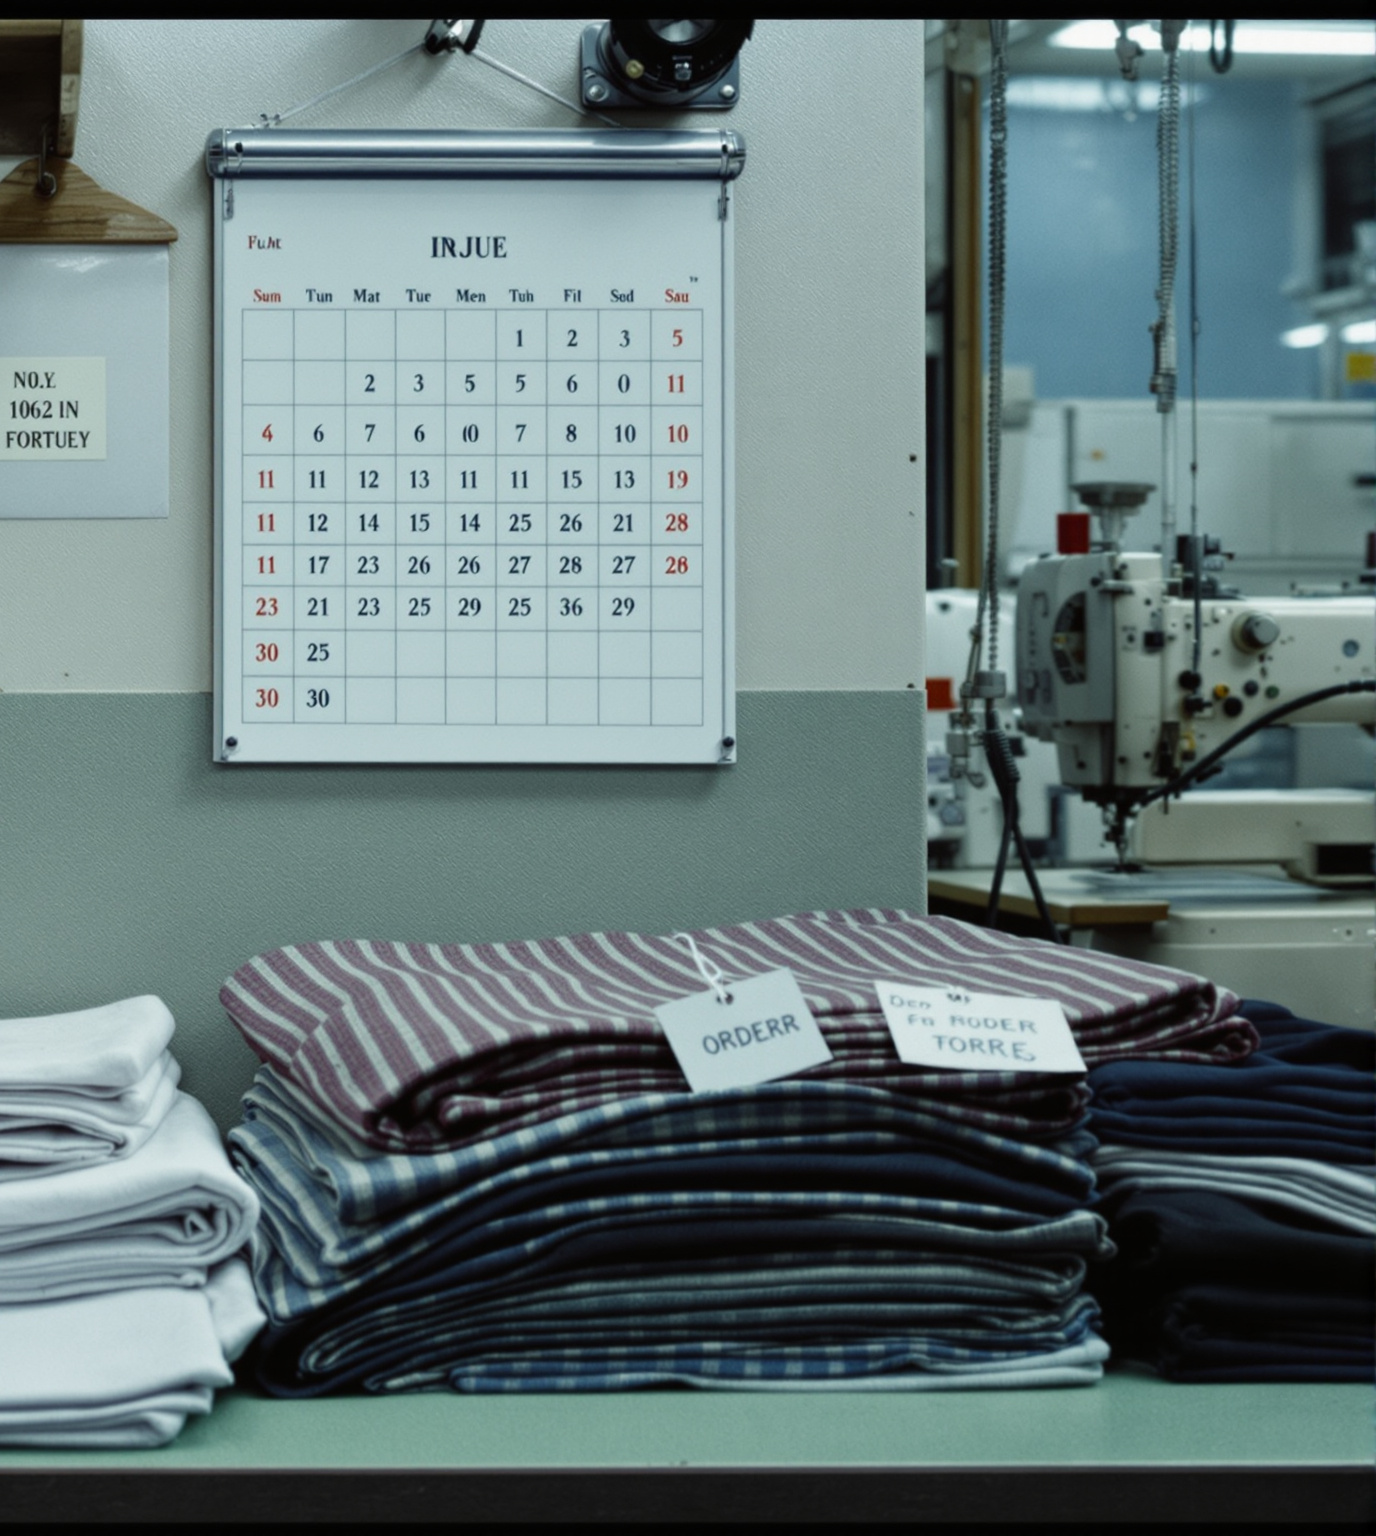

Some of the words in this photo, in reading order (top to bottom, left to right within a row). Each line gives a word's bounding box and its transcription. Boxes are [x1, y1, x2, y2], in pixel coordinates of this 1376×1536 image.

[305, 288, 333, 303] Tun
[353, 288, 380, 303] Mat
[456, 288, 486, 303] Men
[516, 329, 523, 348] 1
[566, 328, 578, 348] 2
[619, 329, 631, 348] 3
[672, 329, 683, 347] 5
[364, 373, 376, 393] 2
[413, 373, 425, 393] 3
[464, 374, 476, 393] 5
[515, 373, 526, 393] 5
[566, 374, 578, 393] 6
[617, 373, 631, 394] 0
[668, 374, 684, 393] 11
[10, 399, 53, 420] 1062
[59, 400, 79, 419] IN
[6, 430, 90, 449] FORTUEY
[261, 424, 273, 442] 4
[313, 423, 325, 443] 6
[364, 423, 376, 443] 7
[413, 424, 426, 443] 6
[515, 423, 527, 443] 7
[565, 423, 577, 443] 8
[615, 423, 637, 443] 10
[668, 424, 689, 443] 10
[259, 470, 274, 489] 11
[309, 470, 326, 489] 11
[359, 469, 379, 489] 12
[410, 469, 430, 489] 13
[460, 470, 477, 489] 11
[511, 470, 528, 489] 11
[562, 470, 583, 489] 15
[615, 470, 635, 489] 13
[668, 470, 689, 489] 19
[258, 513, 275, 532] 11
[308, 513, 328, 532] 12
[359, 513, 380, 532] 14
[410, 513, 430, 532] 15
[460, 513, 481, 532] 14
[508, 513, 532, 532] 25
[559, 513, 583, 532] 26
[613, 513, 633, 533] 21
[665, 513, 689, 532] 28
[258, 556, 275, 574] 11
[309, 555, 330, 575] 17
[357, 555, 380, 574] 23
[407, 555, 431, 575] 26
[457, 555, 481, 575] 26
[508, 555, 532, 575] 27
[559, 555, 583, 575] 28
[611, 555, 636, 575] 27
[255, 597, 278, 616] 23
[307, 597, 328, 617] 21
[357, 597, 381, 617] 23
[408, 597, 431, 617] 25
[458, 597, 482, 617] 29
[508, 597, 532, 617] 25
[559, 597, 583, 617] 36
[611, 597, 635, 617] 29
[255, 643, 279, 662] 30
[306, 642, 330, 662] 25
[255, 688, 279, 708] 30
[306, 688, 330, 708] 30
[702, 1013, 801, 1057] ORDERR
